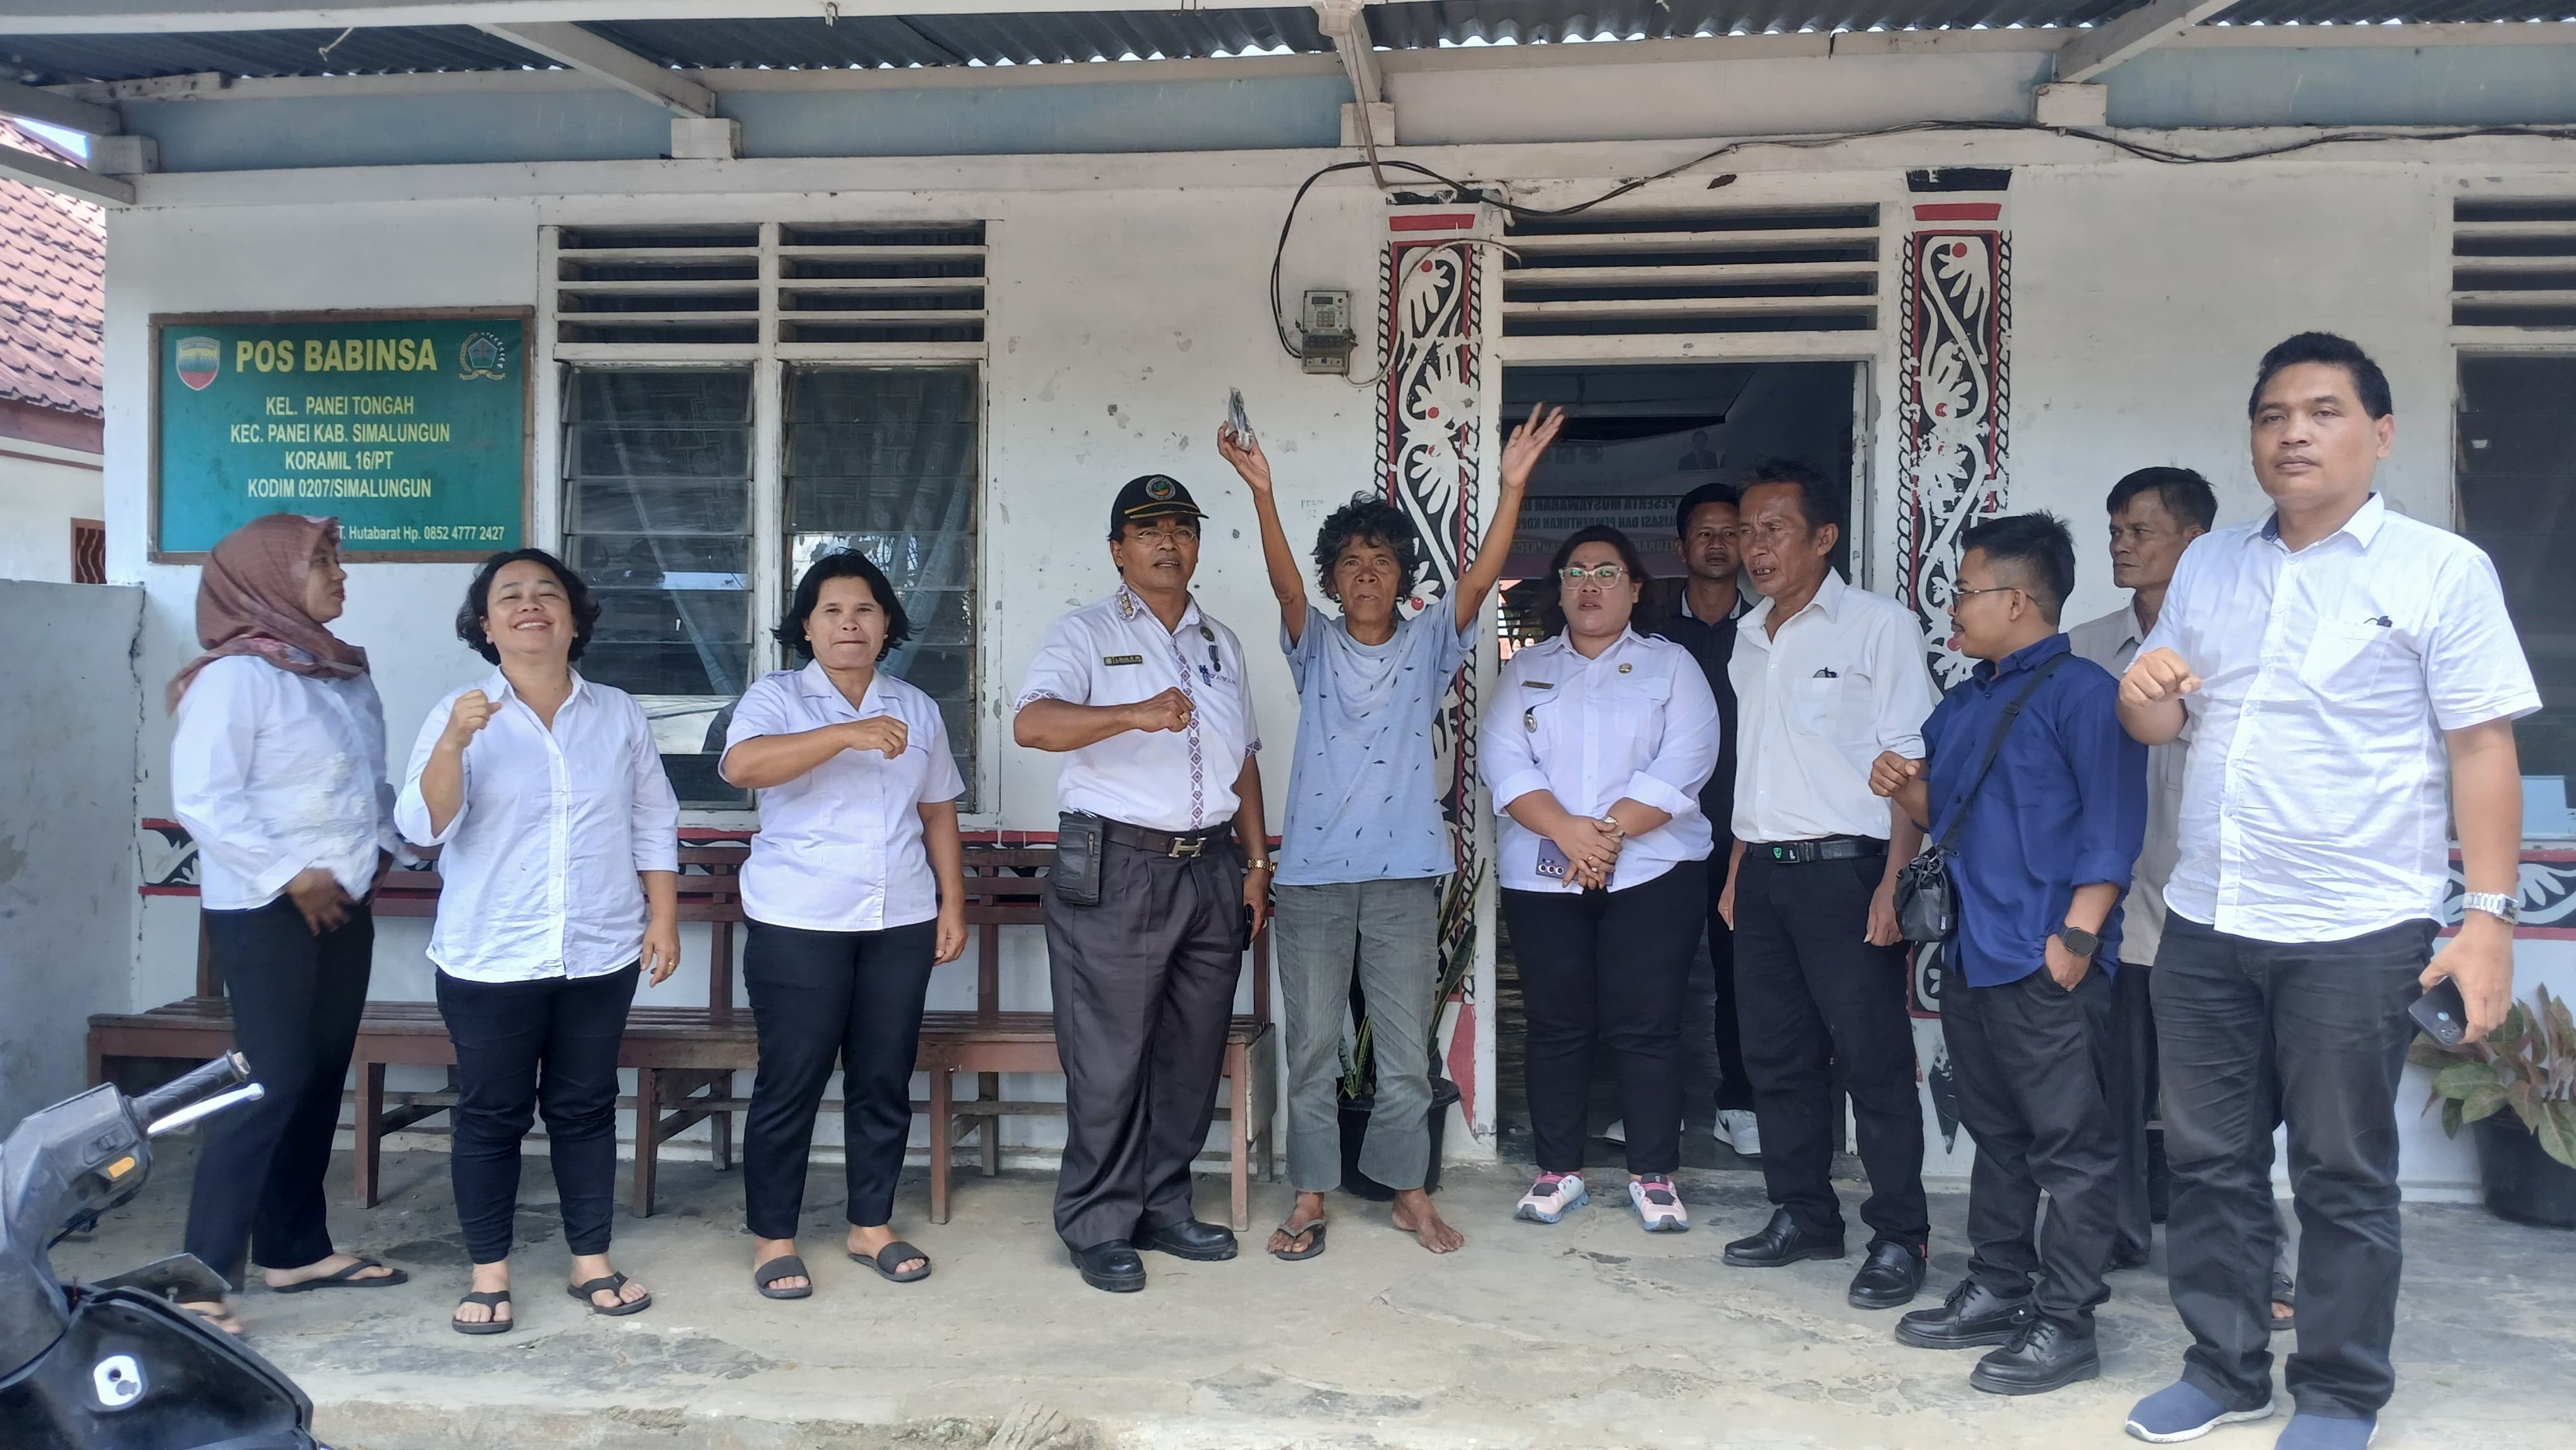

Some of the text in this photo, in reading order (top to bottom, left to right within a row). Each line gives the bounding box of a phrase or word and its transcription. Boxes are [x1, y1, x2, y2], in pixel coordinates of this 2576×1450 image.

[237, 339, 438, 373] POS BABINSA
[266, 395, 414, 416] KEL. PANEI TONGAH
[231, 423, 450, 443] KEC. PANEI KAB. SIMALUNGUN
[285, 451, 393, 470] KORAMIL 16/PT
[248, 478, 431, 498] KODIM 0207/SIMALUNGUN
[349, 525, 401, 540] Hutabarat
[403, 526, 421, 543] Hp.
[424, 526, 448, 540] 0852
[451, 526, 477, 540] 4777
[479, 526, 504, 540] 2427
